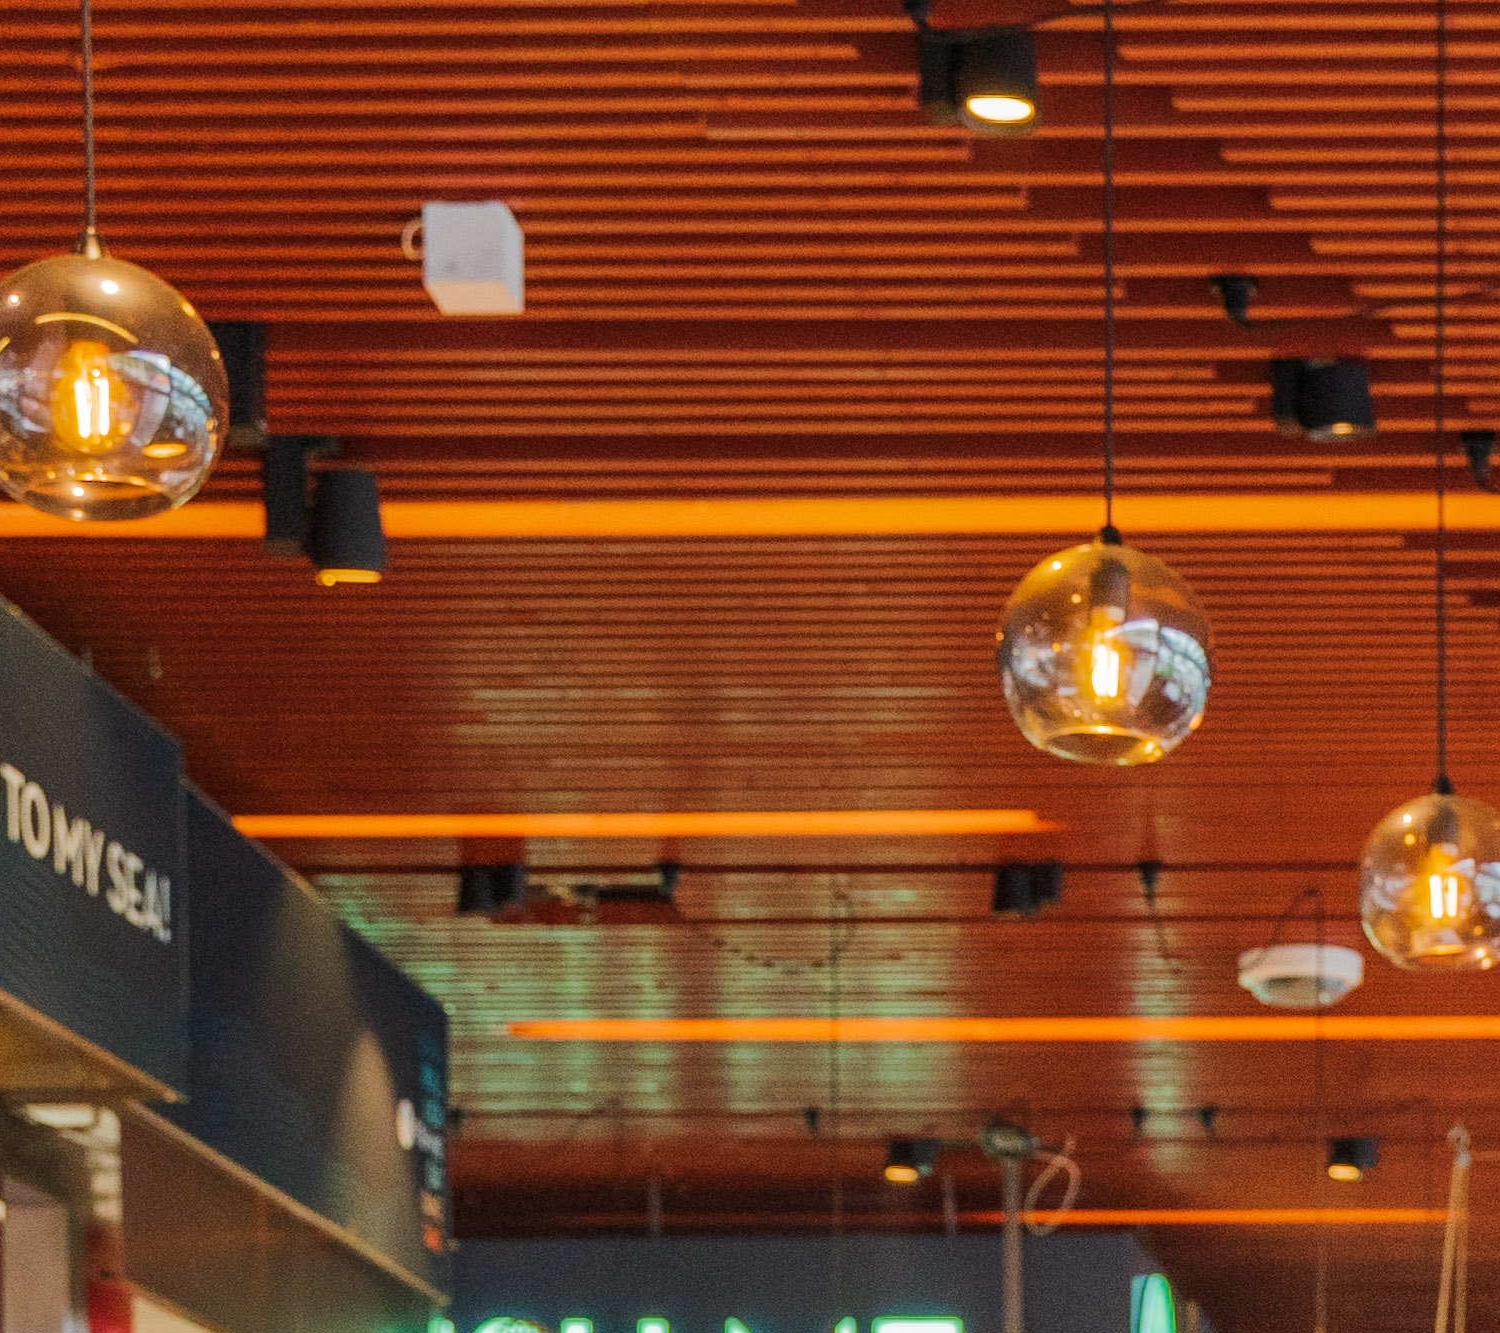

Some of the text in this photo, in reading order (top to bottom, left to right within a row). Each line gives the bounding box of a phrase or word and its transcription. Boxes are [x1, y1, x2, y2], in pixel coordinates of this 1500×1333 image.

[0, 762, 50, 860] TO
[53, 804, 105, 897] MY
[106, 840, 171, 944] SEA!
